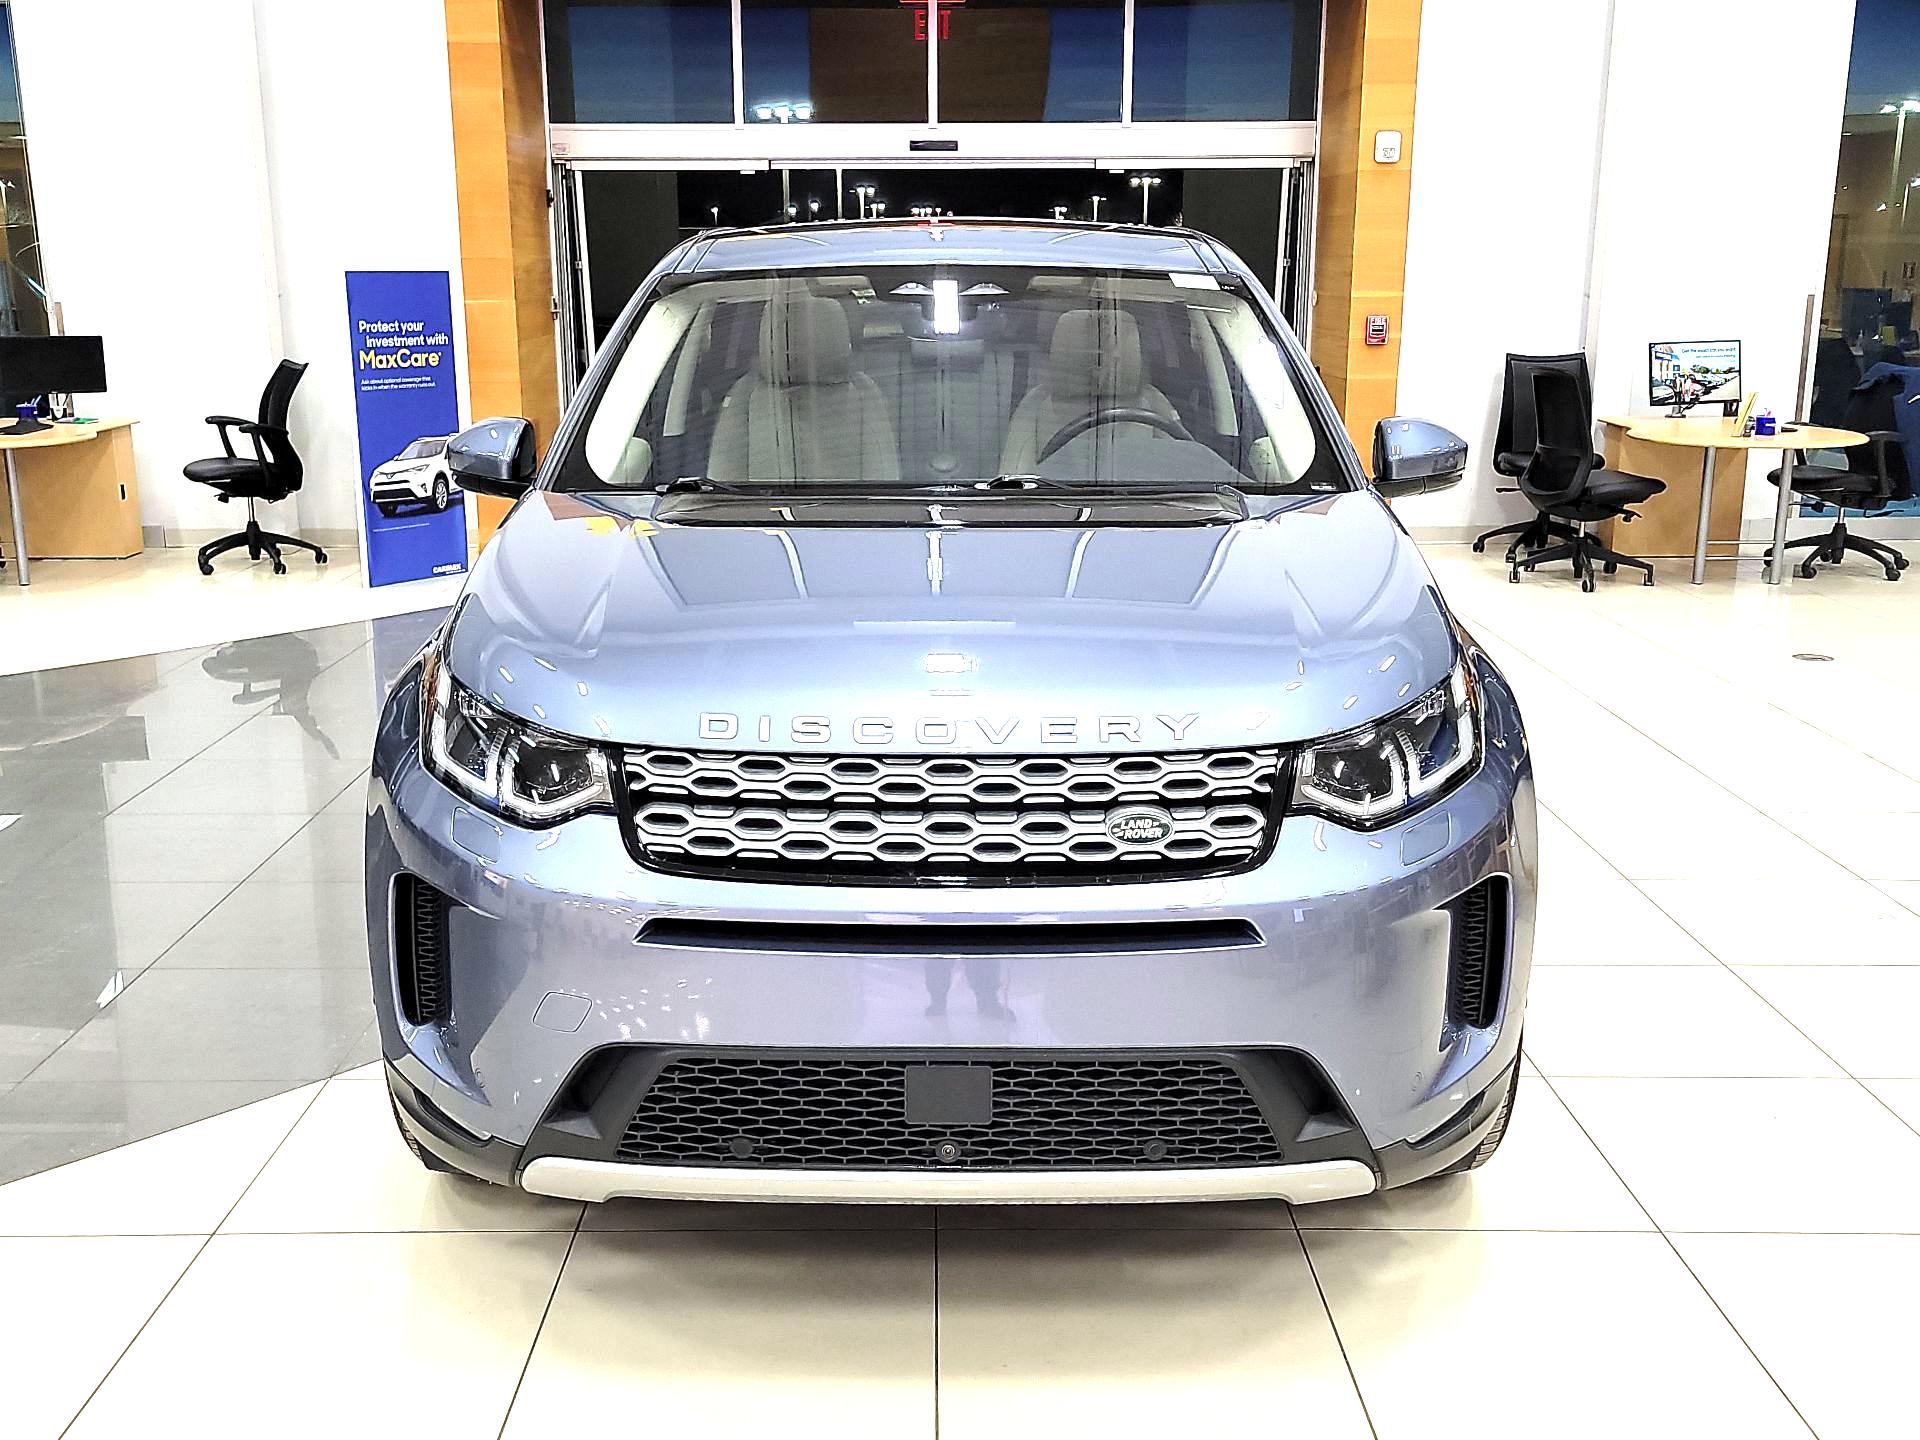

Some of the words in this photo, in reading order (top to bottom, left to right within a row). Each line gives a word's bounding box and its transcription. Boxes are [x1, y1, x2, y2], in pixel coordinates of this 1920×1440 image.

[914, 9, 952, 40] ET
[359, 320, 400, 333] Protect
[400, 321, 424, 335] your
[366, 334, 425, 348] investment
[426, 332, 449, 346] with
[359, 348, 440, 370] MaxCare
[699, 712, 1199, 744] DISCOVERY
[1120, 818, 1153, 829] LAND
[1123, 827, 1163, 839] ROVER
